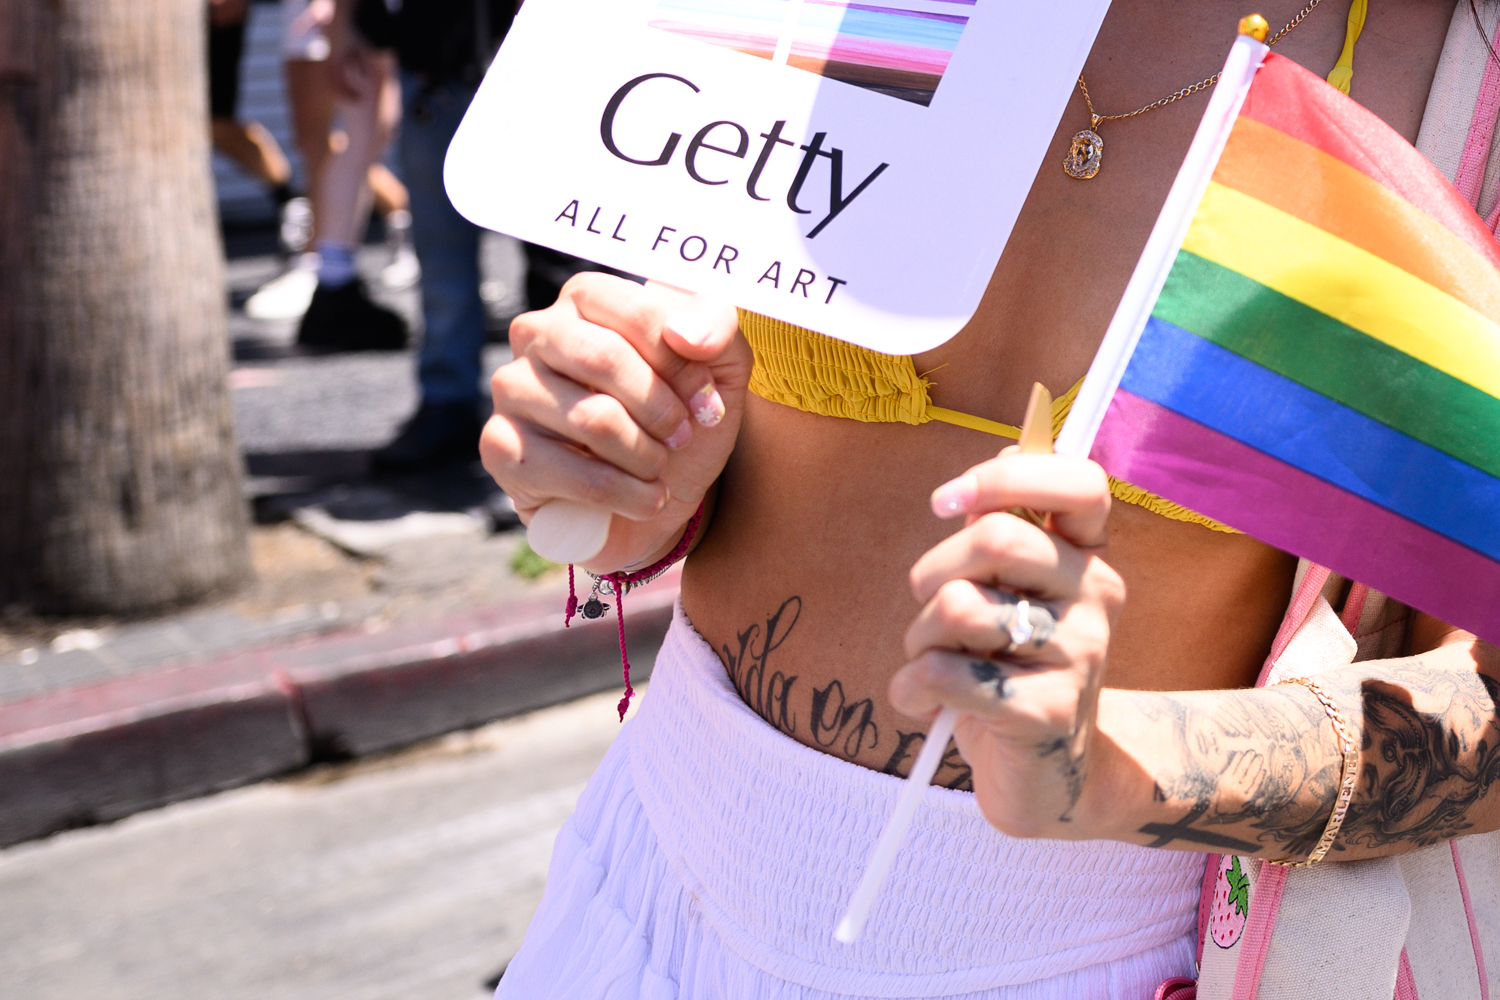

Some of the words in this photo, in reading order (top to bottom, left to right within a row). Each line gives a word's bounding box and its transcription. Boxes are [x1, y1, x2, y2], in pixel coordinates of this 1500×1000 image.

[599, 72, 890, 239] Getty
[555, 199, 627, 242] ALL
[652, 226, 739, 275] FOR
[757, 260, 848, 305] ART
[1316, 755, 1359, 857] MARLENE
